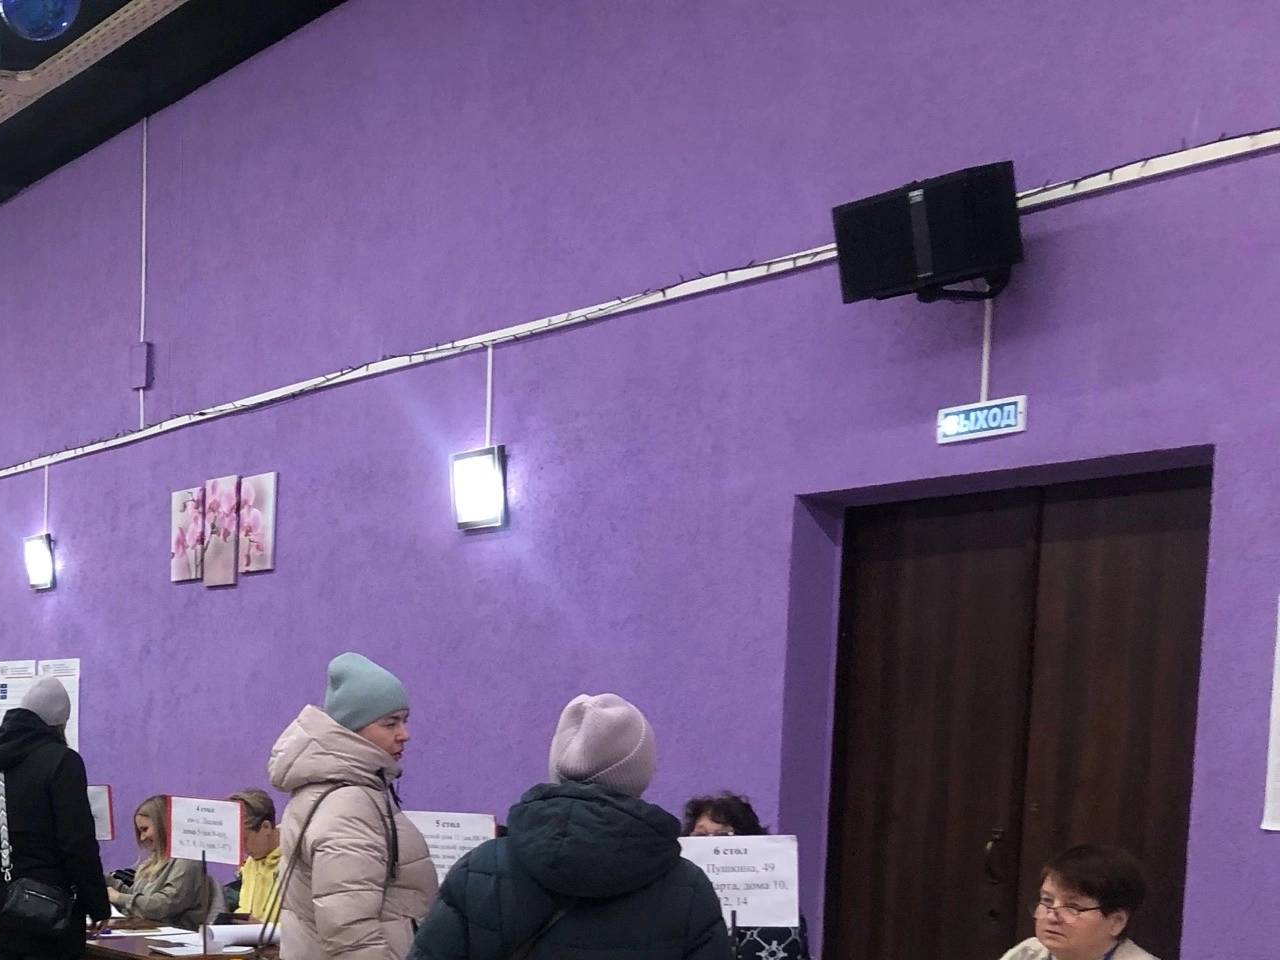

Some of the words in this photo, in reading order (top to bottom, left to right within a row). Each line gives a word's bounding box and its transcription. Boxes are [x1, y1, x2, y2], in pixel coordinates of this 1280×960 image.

[942, 404, 1016, 435] ЫХОД
[435, 820, 440, 828] 5
[713, 847, 720, 856] 6
[722, 848, 748, 856] стол
[713, 883, 740, 892] арта,
